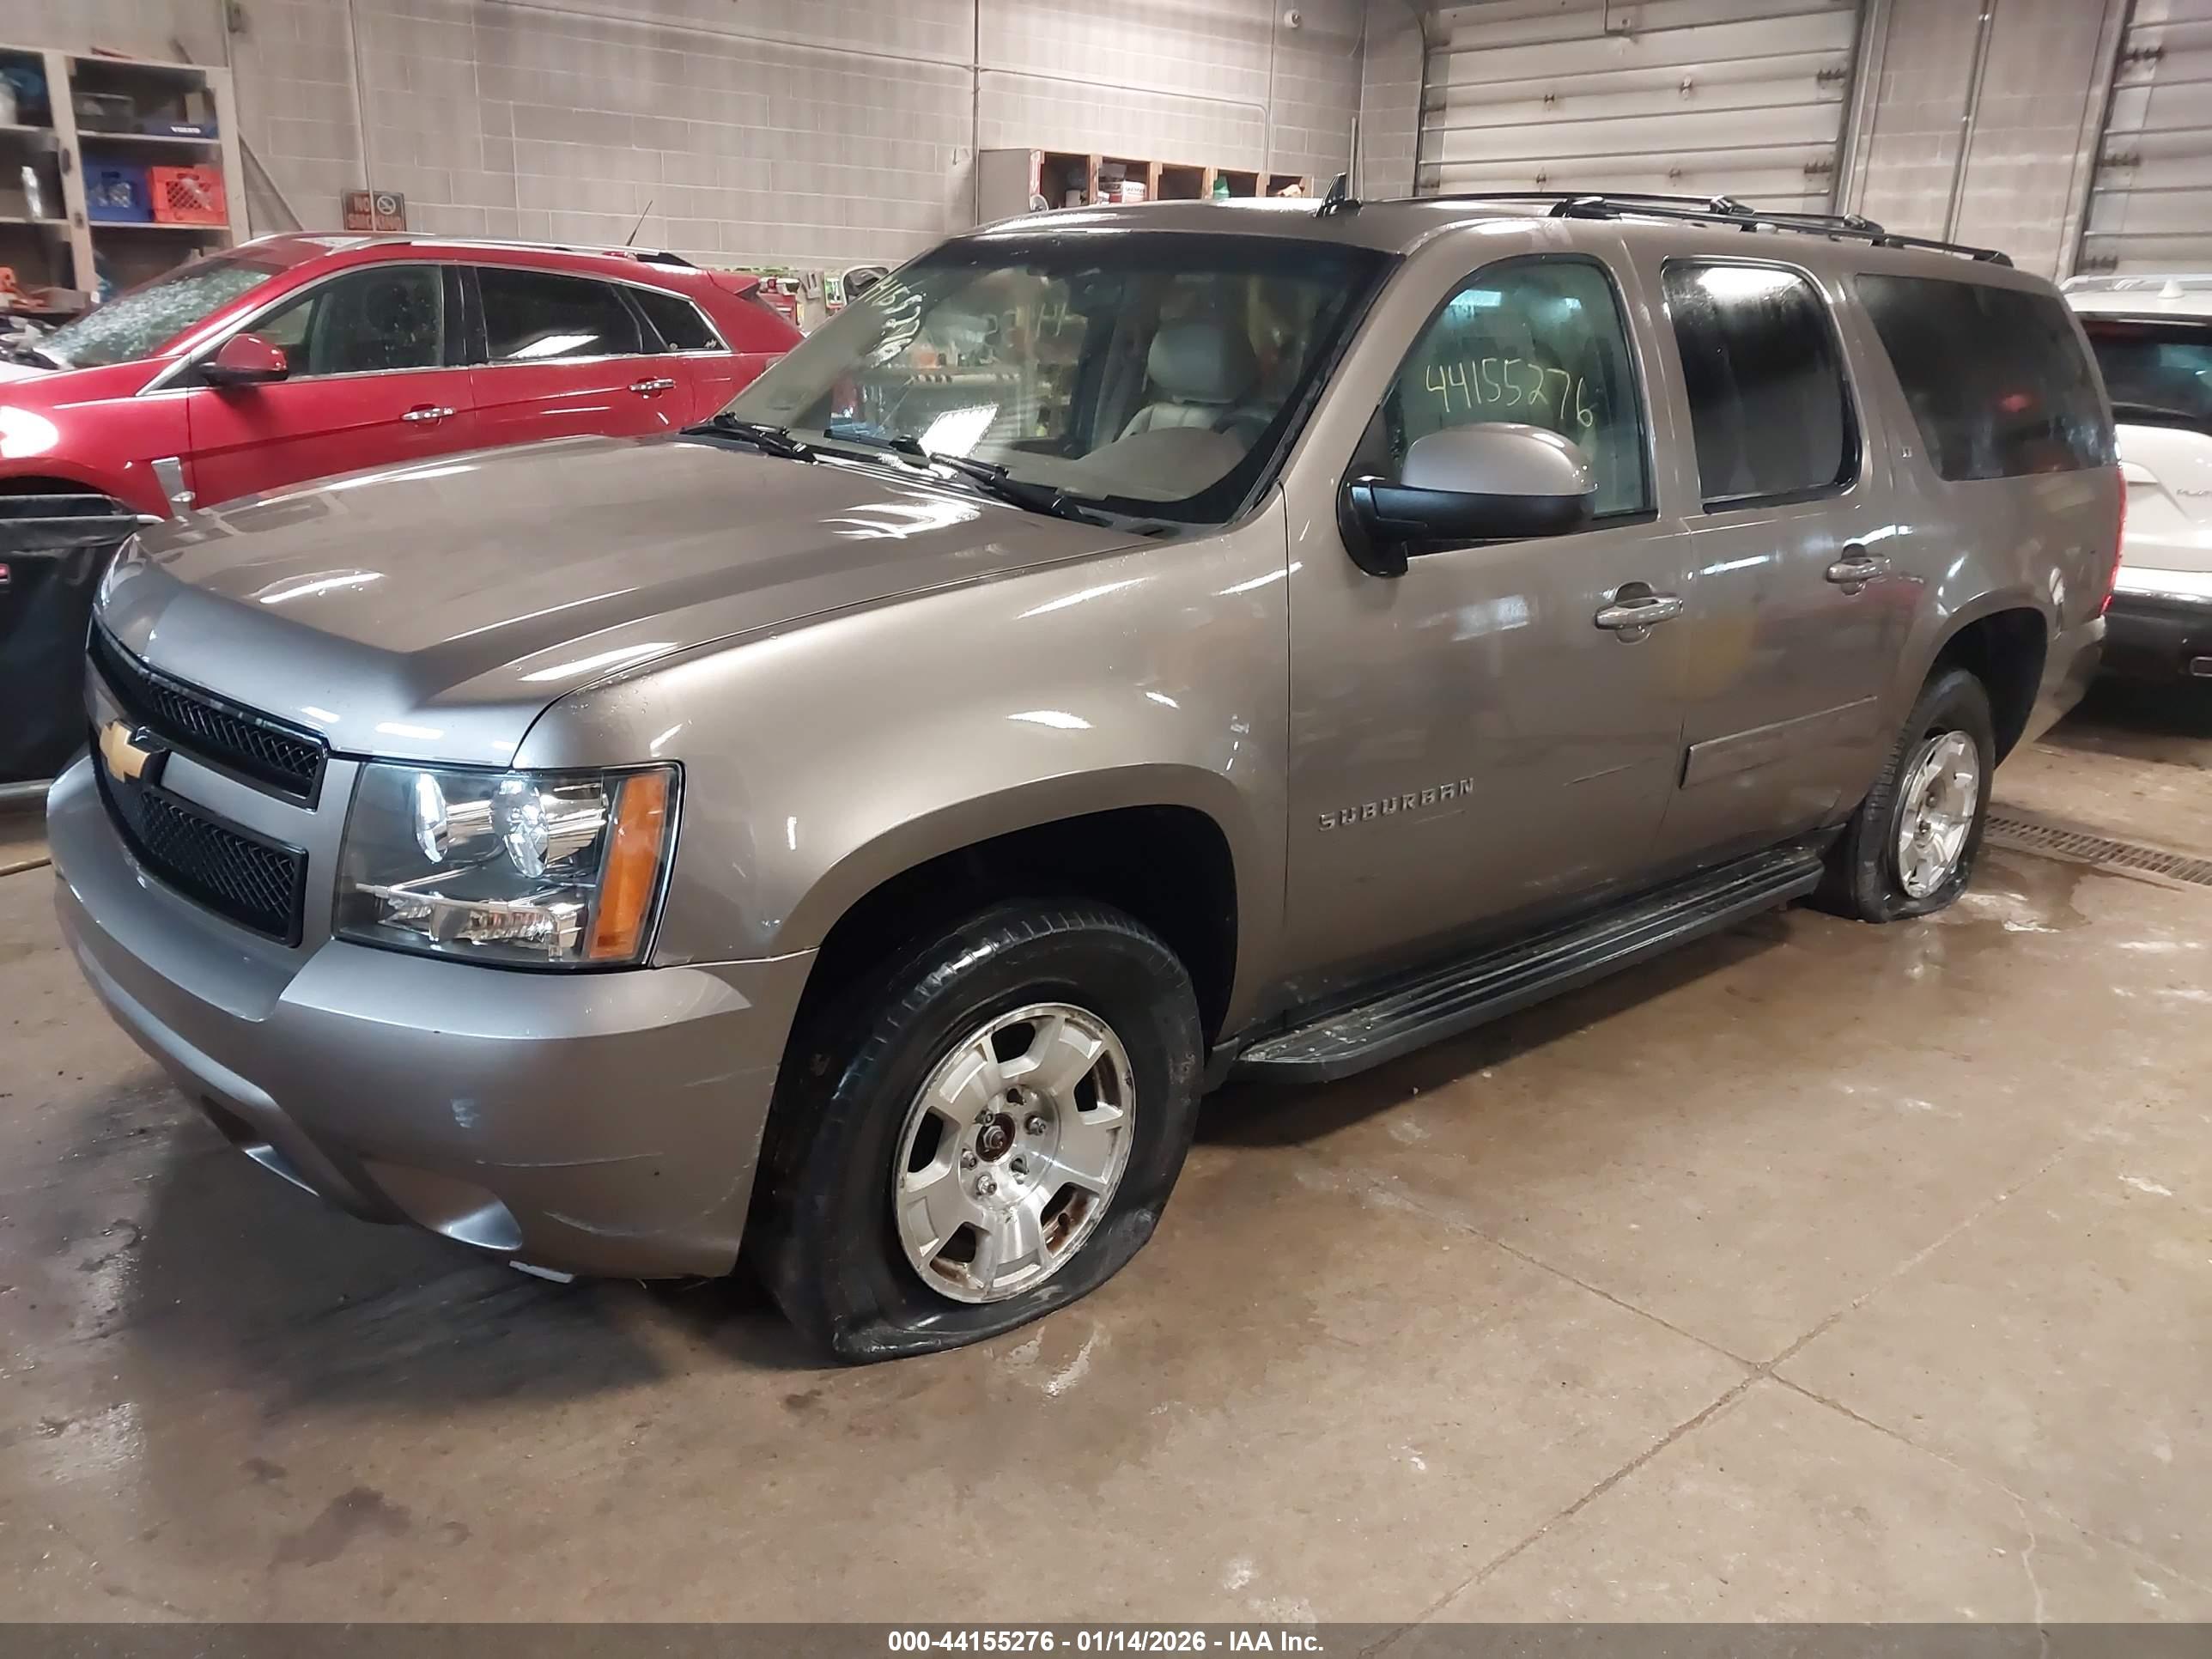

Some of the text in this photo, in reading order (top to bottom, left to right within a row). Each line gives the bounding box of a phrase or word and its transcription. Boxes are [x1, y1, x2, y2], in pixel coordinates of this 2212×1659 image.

[354, 197, 371, 212] NO
[1425, 357, 1594, 428] 44155276
[1318, 777, 1474, 831] SUBURBAN
